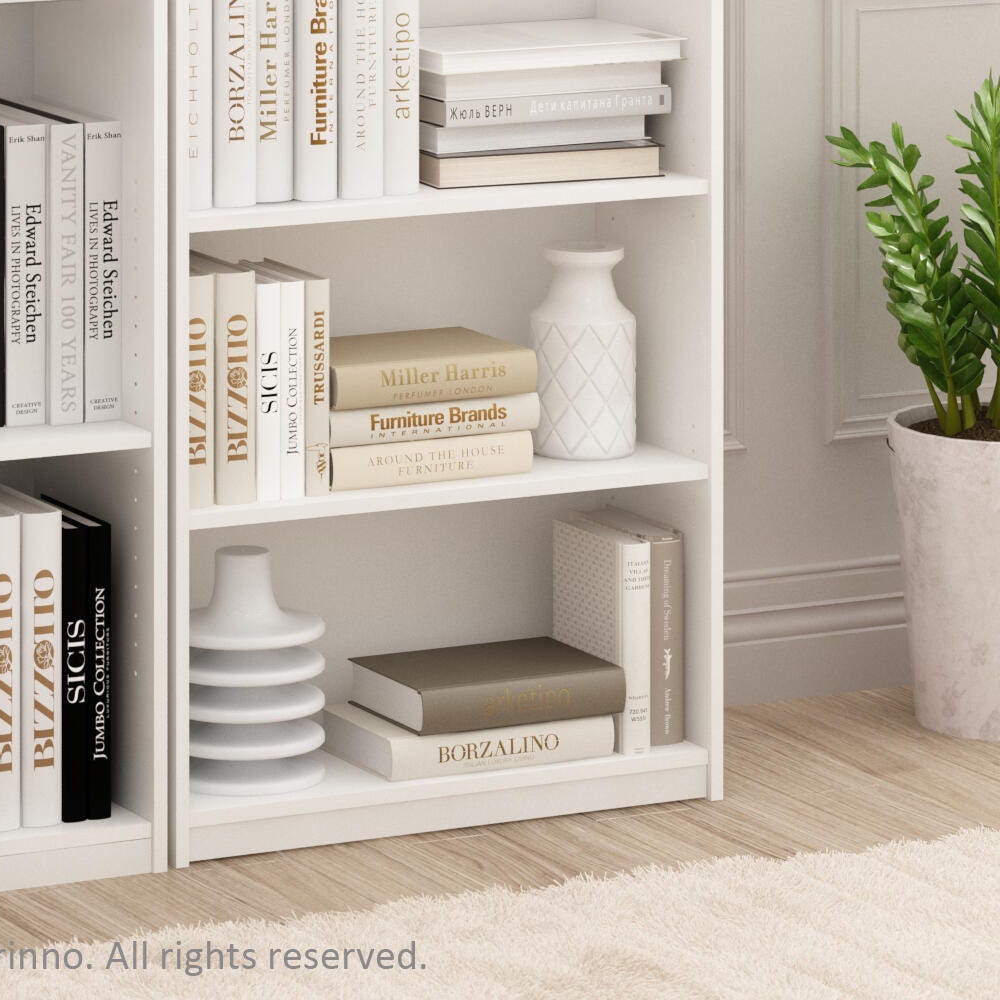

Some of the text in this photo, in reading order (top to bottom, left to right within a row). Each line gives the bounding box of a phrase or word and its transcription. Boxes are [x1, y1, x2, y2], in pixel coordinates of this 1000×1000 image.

[356, 29, 366, 64] THE
[369, 0, 377, 108] FURNITURE
[389, 12, 415, 119] arketipo
[260, 59, 277, 143] Miller
[310, 41, 327, 146] Furniture
[356, 74, 366, 151] AROUND
[450, 107, 481, 120] Жюль
[485, 103, 513, 118] ВЕРН
[11, 205, 21, 237] LIVES
[89, 202, 99, 234] LIVES
[11, 241, 21, 253] IN
[89, 237, 99, 250] IN
[25, 203, 42, 343] Edward Steichen
[60, 133, 77, 414] VANITY FAIR 100 YEARS
[102, 200, 119, 340] Edward Steichen
[314, 311, 325, 405] TRUSSARDI
[260, 351, 278, 414] SICIS
[380, 361, 507, 388] Miller Harris
[11, 401, 42, 409] CREATIVE
[370, 403, 507, 431] Furniture Brands
[371, 422, 506, 439] INTERNATIONAL
[368, 445, 505, 467] AROUND THE HOUSE
[399, 461, 474, 476] FURNITURE
[663, 559, 672, 599] Dreaming
[663, 600, 672, 608] of
[66, 618, 86, 704] SICIS
[483, 684, 570, 716] arketipo
[438, 733, 560, 764] BORZALINO
